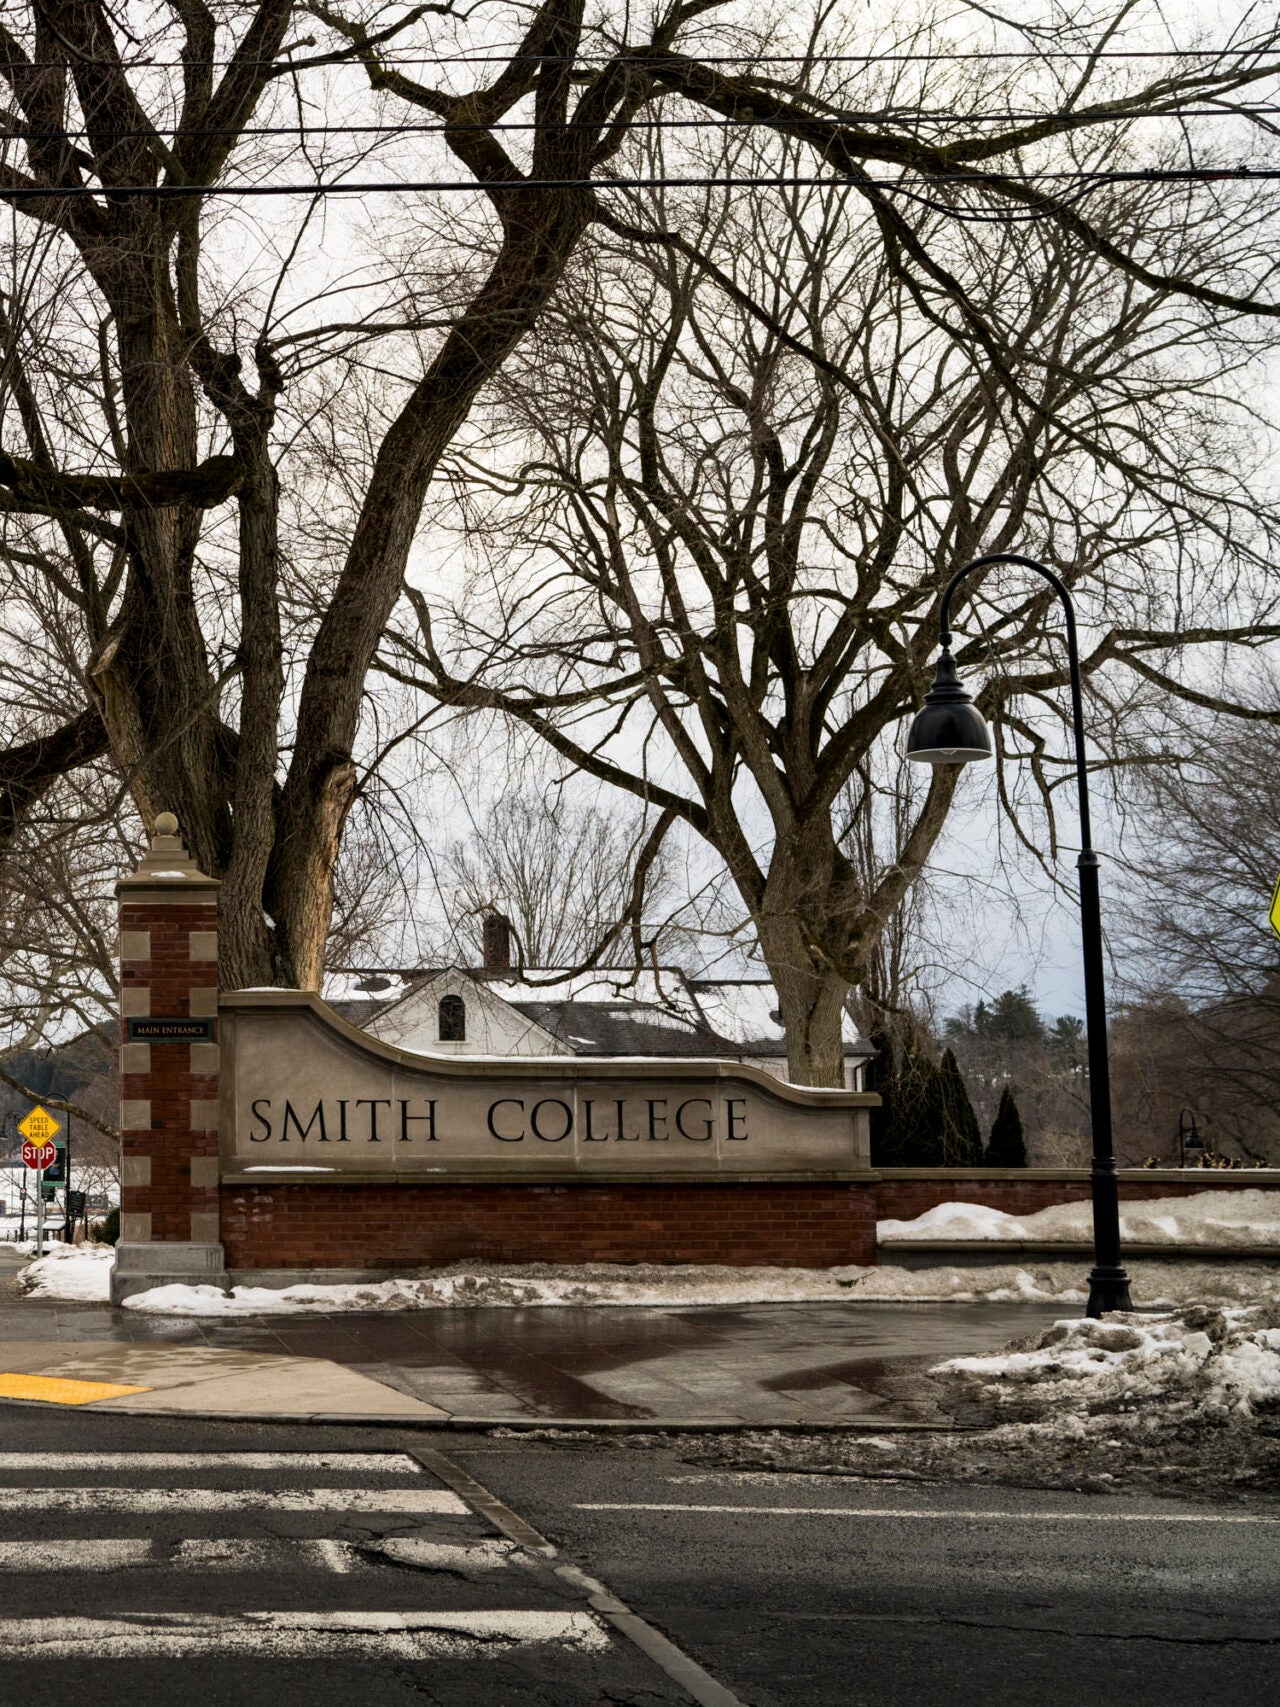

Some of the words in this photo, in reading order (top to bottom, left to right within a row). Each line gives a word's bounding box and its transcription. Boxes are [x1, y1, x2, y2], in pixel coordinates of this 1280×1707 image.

[137, 1026, 160, 1034] MAIN
[162, 1026, 205, 1034] ENTRANCE
[29, 1116, 49, 1124] SPEED
[249, 1098, 441, 1143] SMITH
[486, 1098, 749, 1143] COLLEGE
